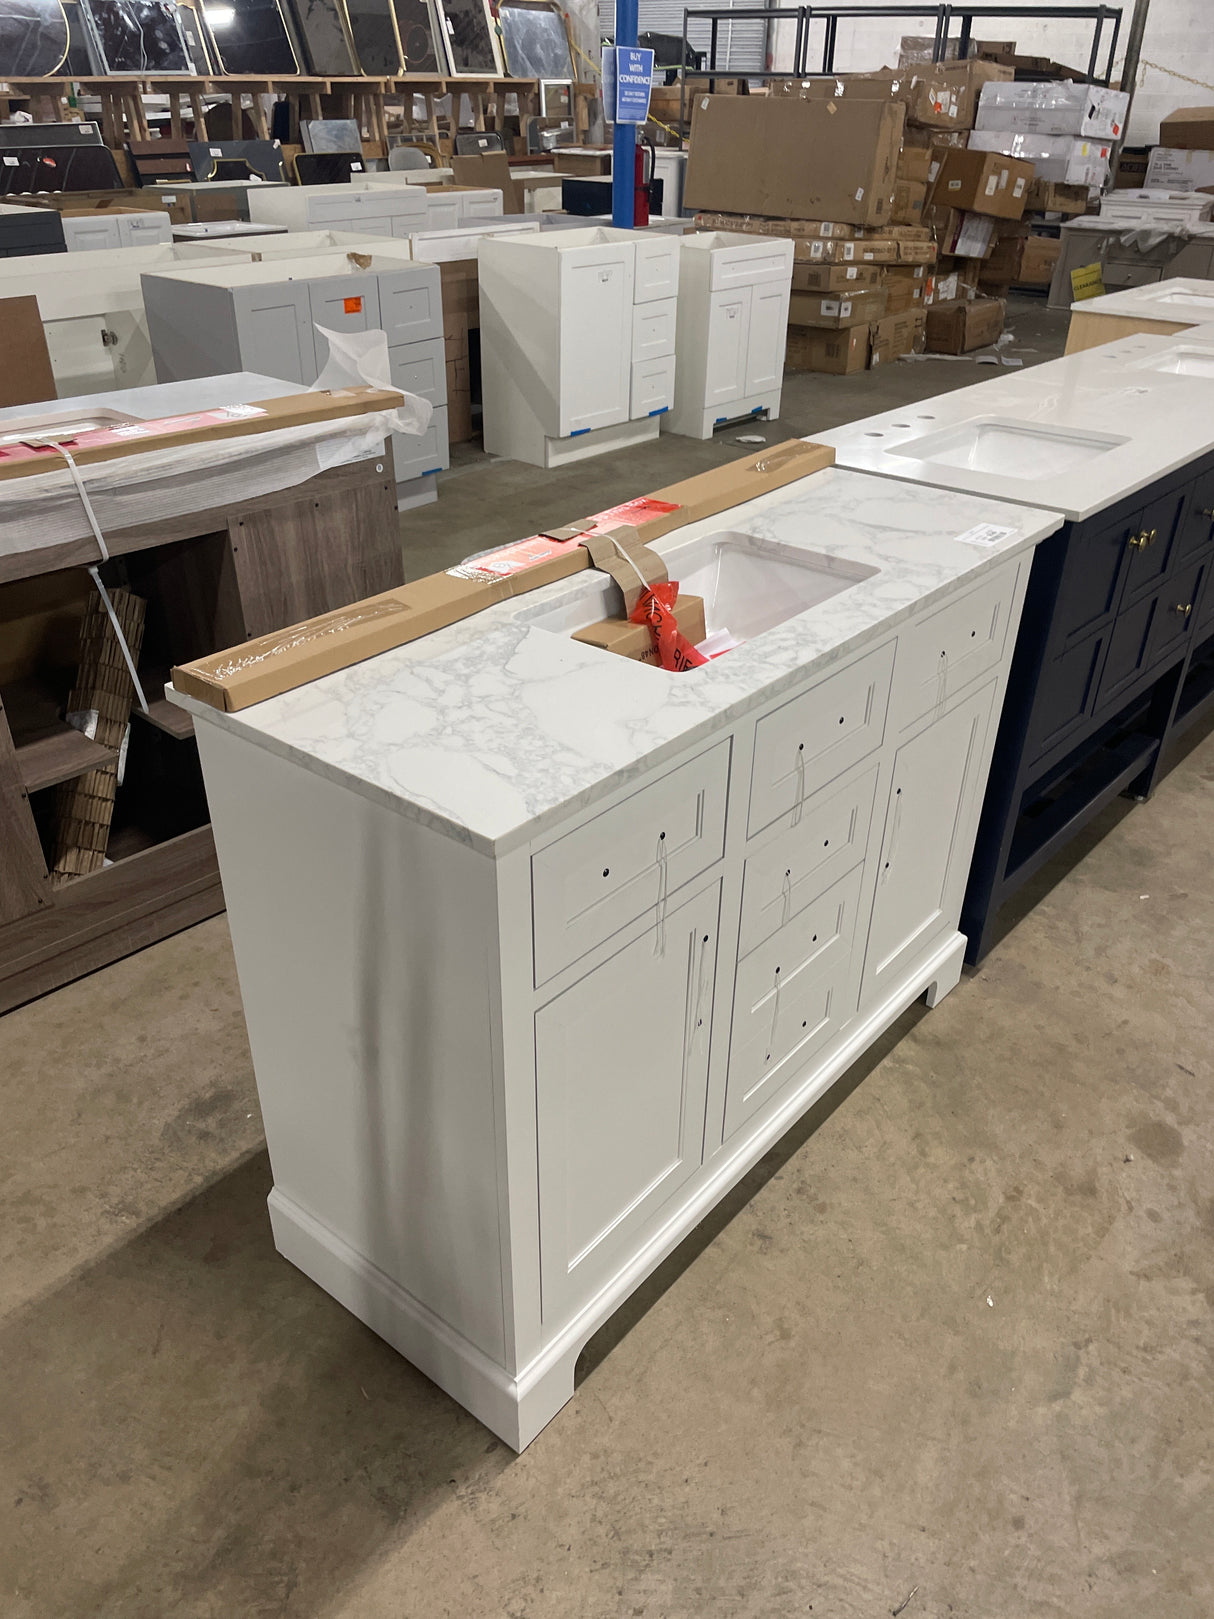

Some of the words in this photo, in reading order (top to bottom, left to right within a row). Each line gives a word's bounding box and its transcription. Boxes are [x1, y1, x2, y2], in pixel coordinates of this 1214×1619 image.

[630, 52, 641, 61] BUY
[629, 64, 643, 73] WITH
[619, 74, 651, 85] CONFIDENCE
